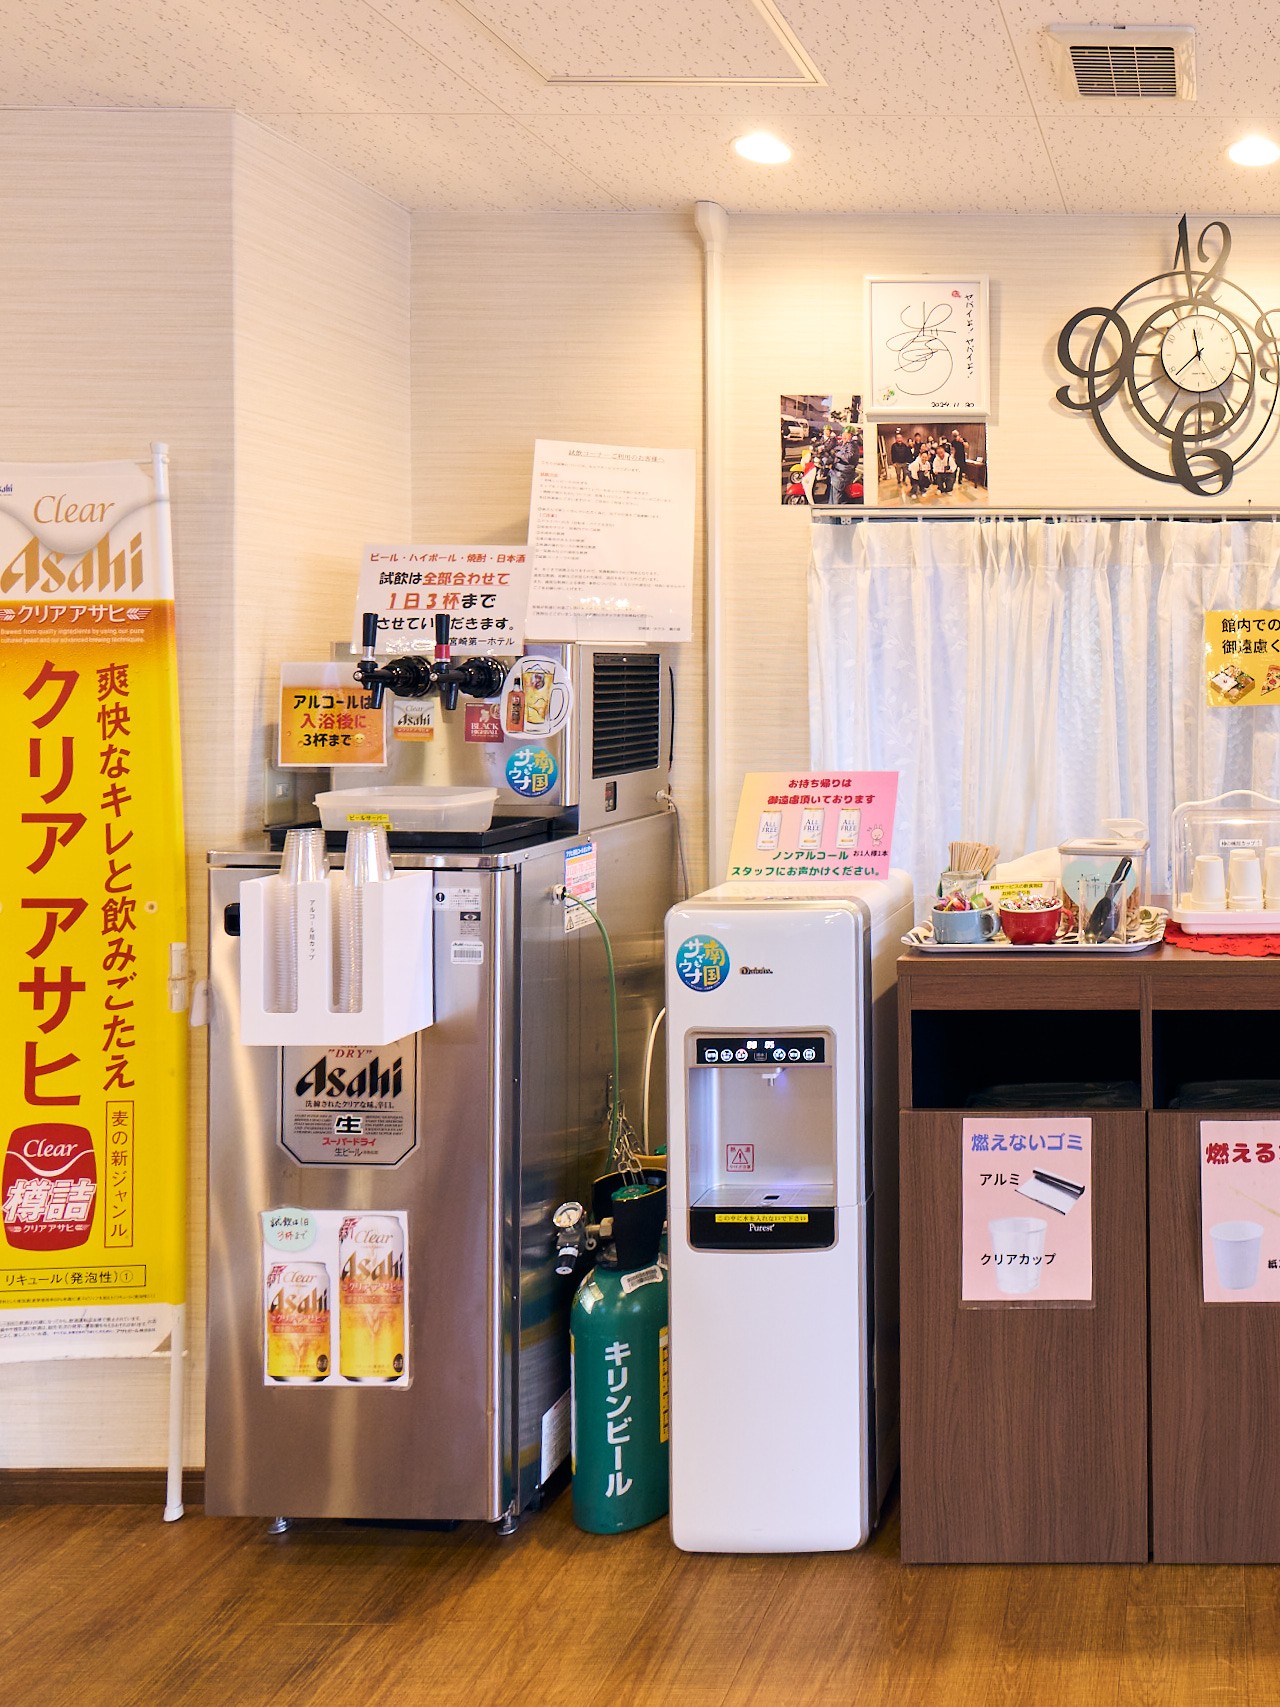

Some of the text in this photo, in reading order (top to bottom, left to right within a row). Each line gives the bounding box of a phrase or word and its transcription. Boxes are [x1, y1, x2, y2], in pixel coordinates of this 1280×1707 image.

[1055, 306, 1133, 411] 9
[33, 493, 116, 525] Clear
[1, 531, 145, 594] Asahi
[370, 553, 527, 564] ビール・ハイボール・焼酎・日本酒
[379, 571, 510, 586] 試飲は全部合わせて
[388, 592, 497, 610] 1日3杯まで
[18, 604, 127, 625] クリアアサヒ
[377, 617, 515, 631] させていだきます。
[449, 636, 515, 647] 宮崎第一ホテル
[293, 693, 375, 710] アルコールは
[300, 713, 367, 730] 入浴後に
[397, 713, 431, 726] Asahi
[471, 722, 499, 730] BLACK
[303, 733, 352, 748] 3杯まで
[532, 749, 555, 793] 南国
[788, 778, 853, 789] お持ち帰りは
[767, 794, 876, 805] 御遠慮頂いております
[772, 851, 849, 861] ノンアルコール
[96, 663, 137, 1092] 爽快なキレと飲みごたえ
[731, 866, 881, 877] スタッフにお声かけください。
[19, 659, 89, 1107] クリアアサヒ
[703, 939, 726, 987] 南国
[296, 1055, 402, 1098] Asahi
[336, 1115, 362, 1134] 生
[23, 1139, 78, 1158] Clear
[322, 1137, 377, 1147] スーパードライ
[971, 1133, 1083, 1152] 燃えないゴミ
[334, 1147, 363, 1157] 生ビール
[980, 1173, 1020, 1187] アルミ
[2, 1177, 97, 1223] 樽詰
[24, 1224, 75, 1234] クリアアサヒ
[354, 1229, 394, 1244] Clear
[341, 1250, 403, 1282] Asahi
[980, 1253, 1057, 1266] クリアカップ
[284, 1270, 317, 1283] Clear
[270, 1287, 328, 1314] Asahi
[604, 1341, 634, 1499] キリンビール
